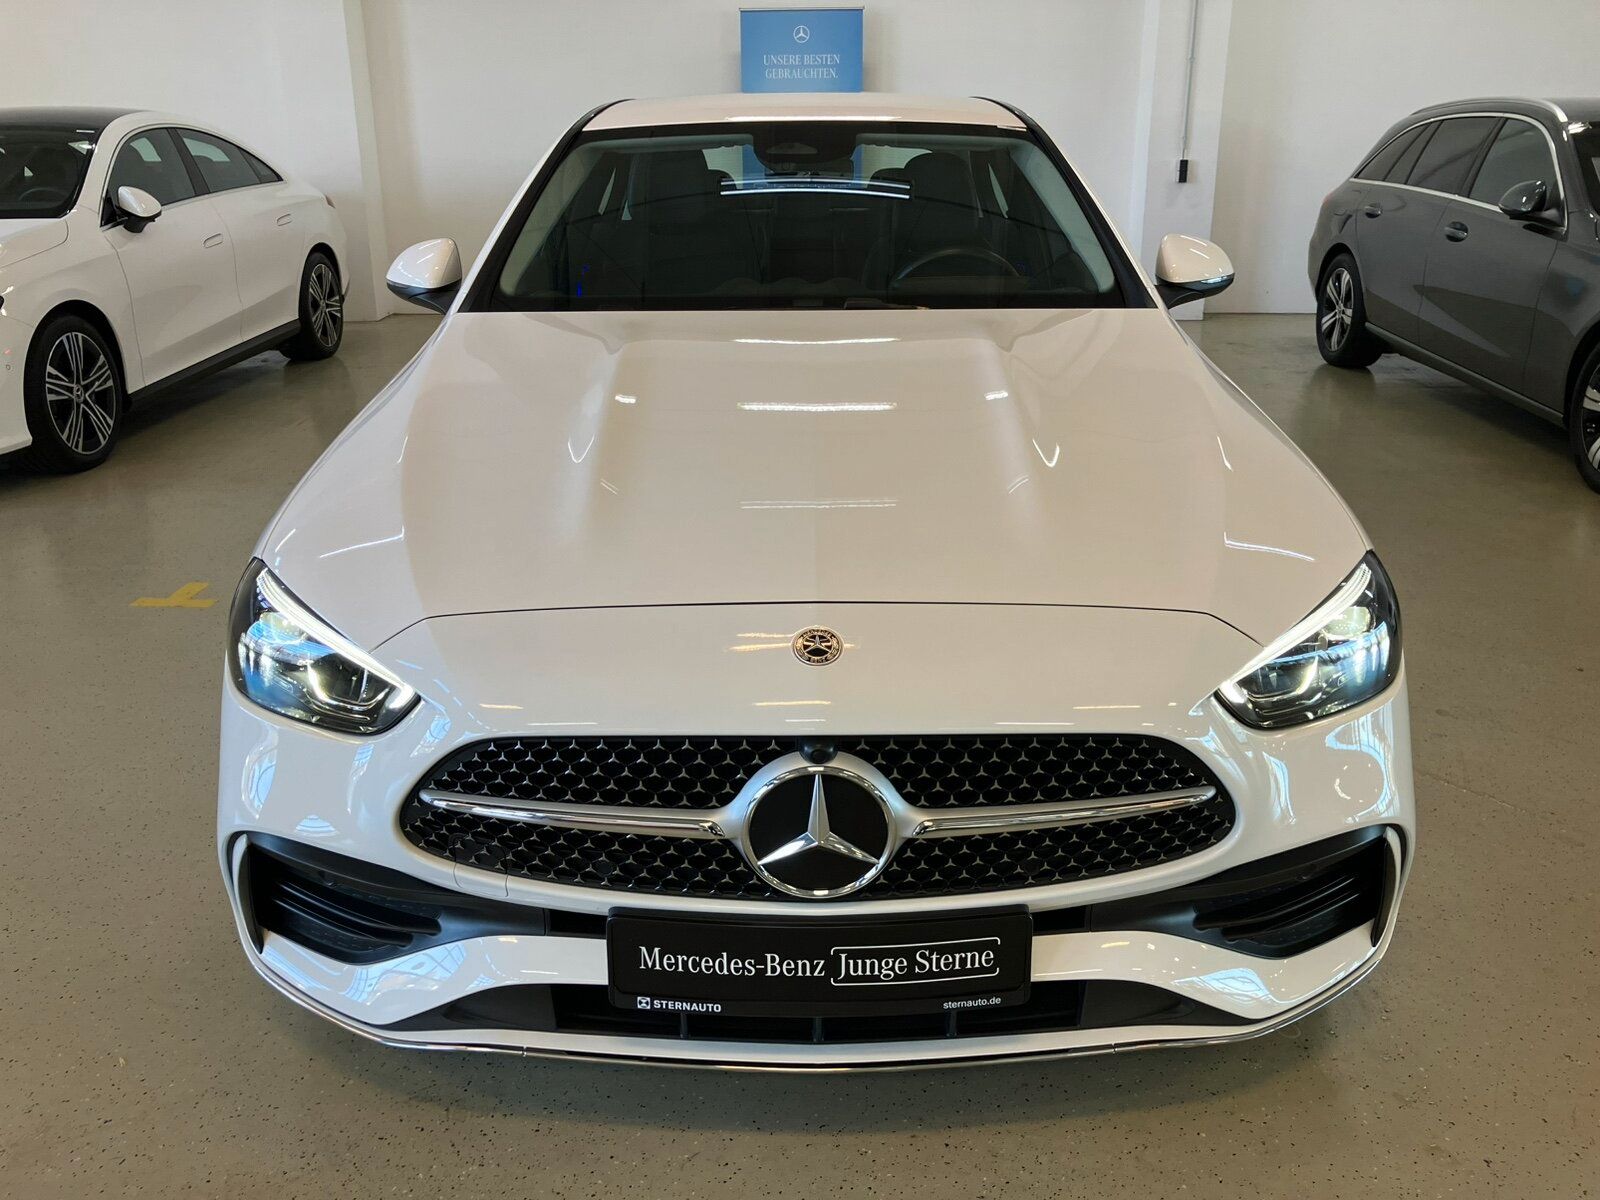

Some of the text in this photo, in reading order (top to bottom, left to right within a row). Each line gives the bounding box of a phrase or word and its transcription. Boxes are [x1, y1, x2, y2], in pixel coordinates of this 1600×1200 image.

[763, 54, 840, 66] UNSERE BESTEN
[765, 67, 839, 79] GEBRAUCHTEN.
[639, 946, 994, 980] Mercedes-Benz Junge Sterne
[653, 1000, 722, 1012] STERNAUTO
[943, 996, 1002, 1009] sternauto.de
